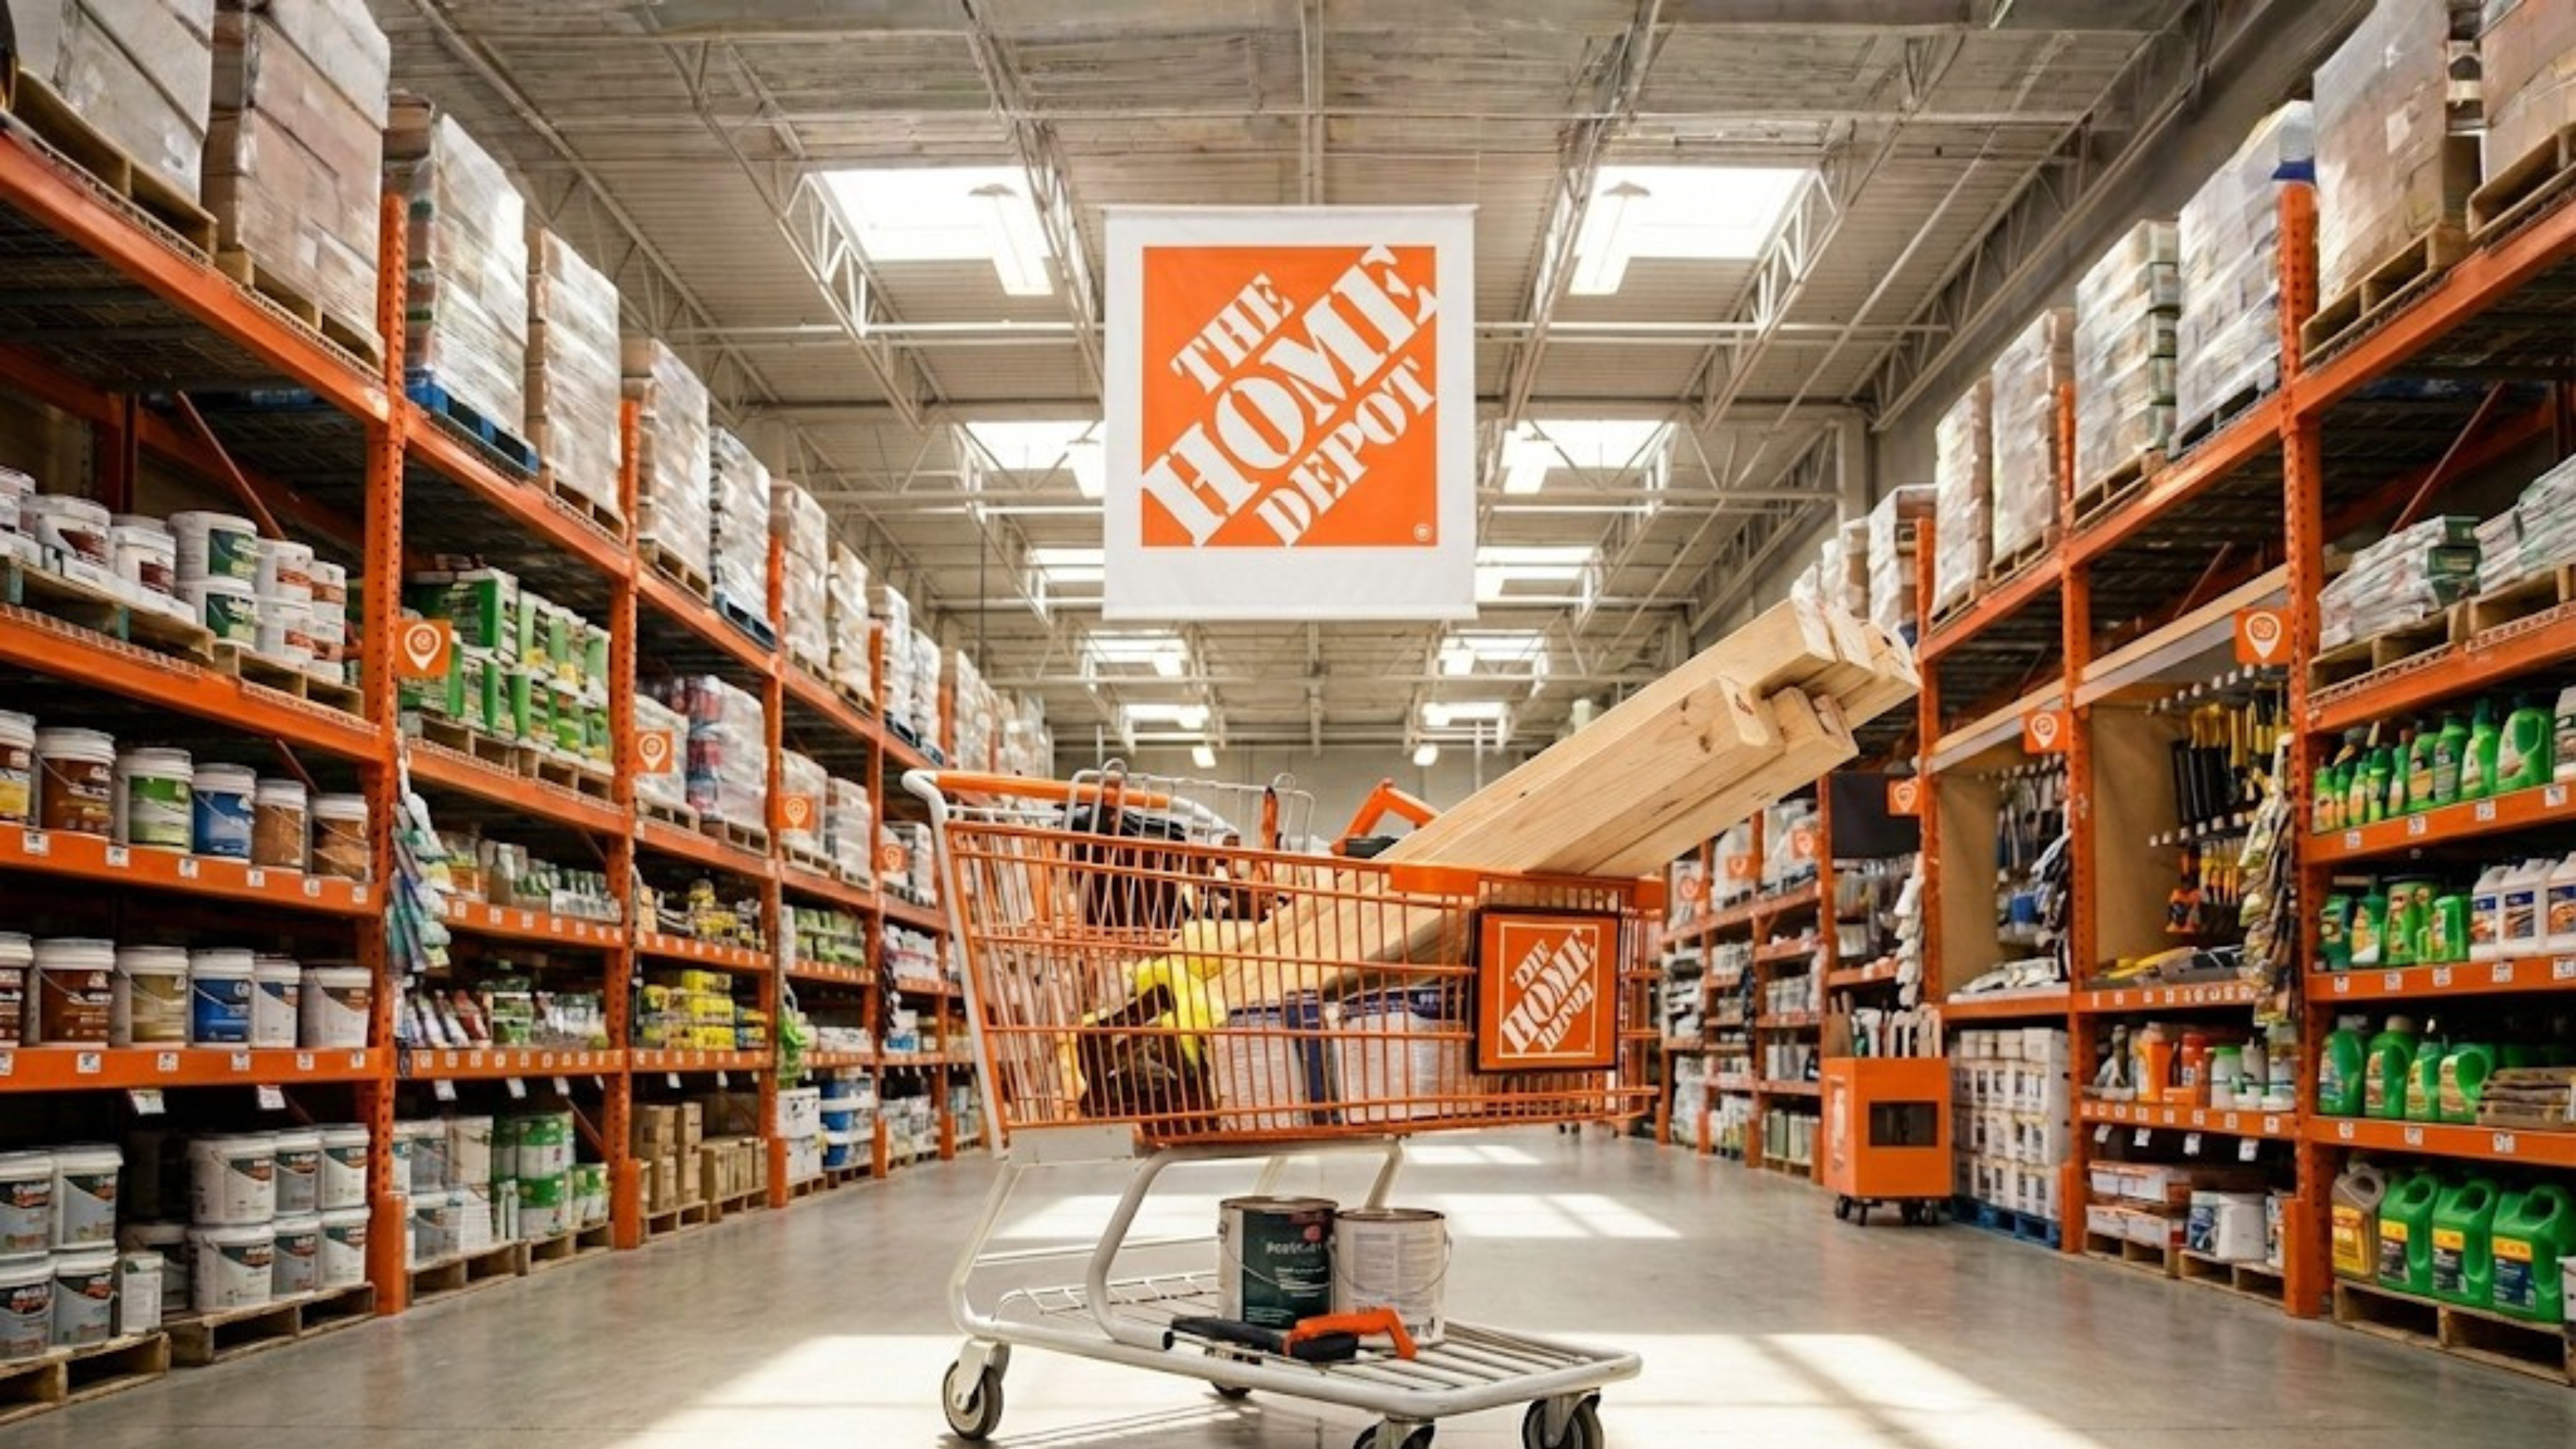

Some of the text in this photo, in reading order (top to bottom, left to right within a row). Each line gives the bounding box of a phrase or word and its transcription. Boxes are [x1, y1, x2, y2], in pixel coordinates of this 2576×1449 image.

[1141, 244, 1438, 547] HOME
[1169, 272, 1295, 395] THE
[1254, 356, 1436, 547] DEPOT
[1502, 927, 1596, 1054] HOME
